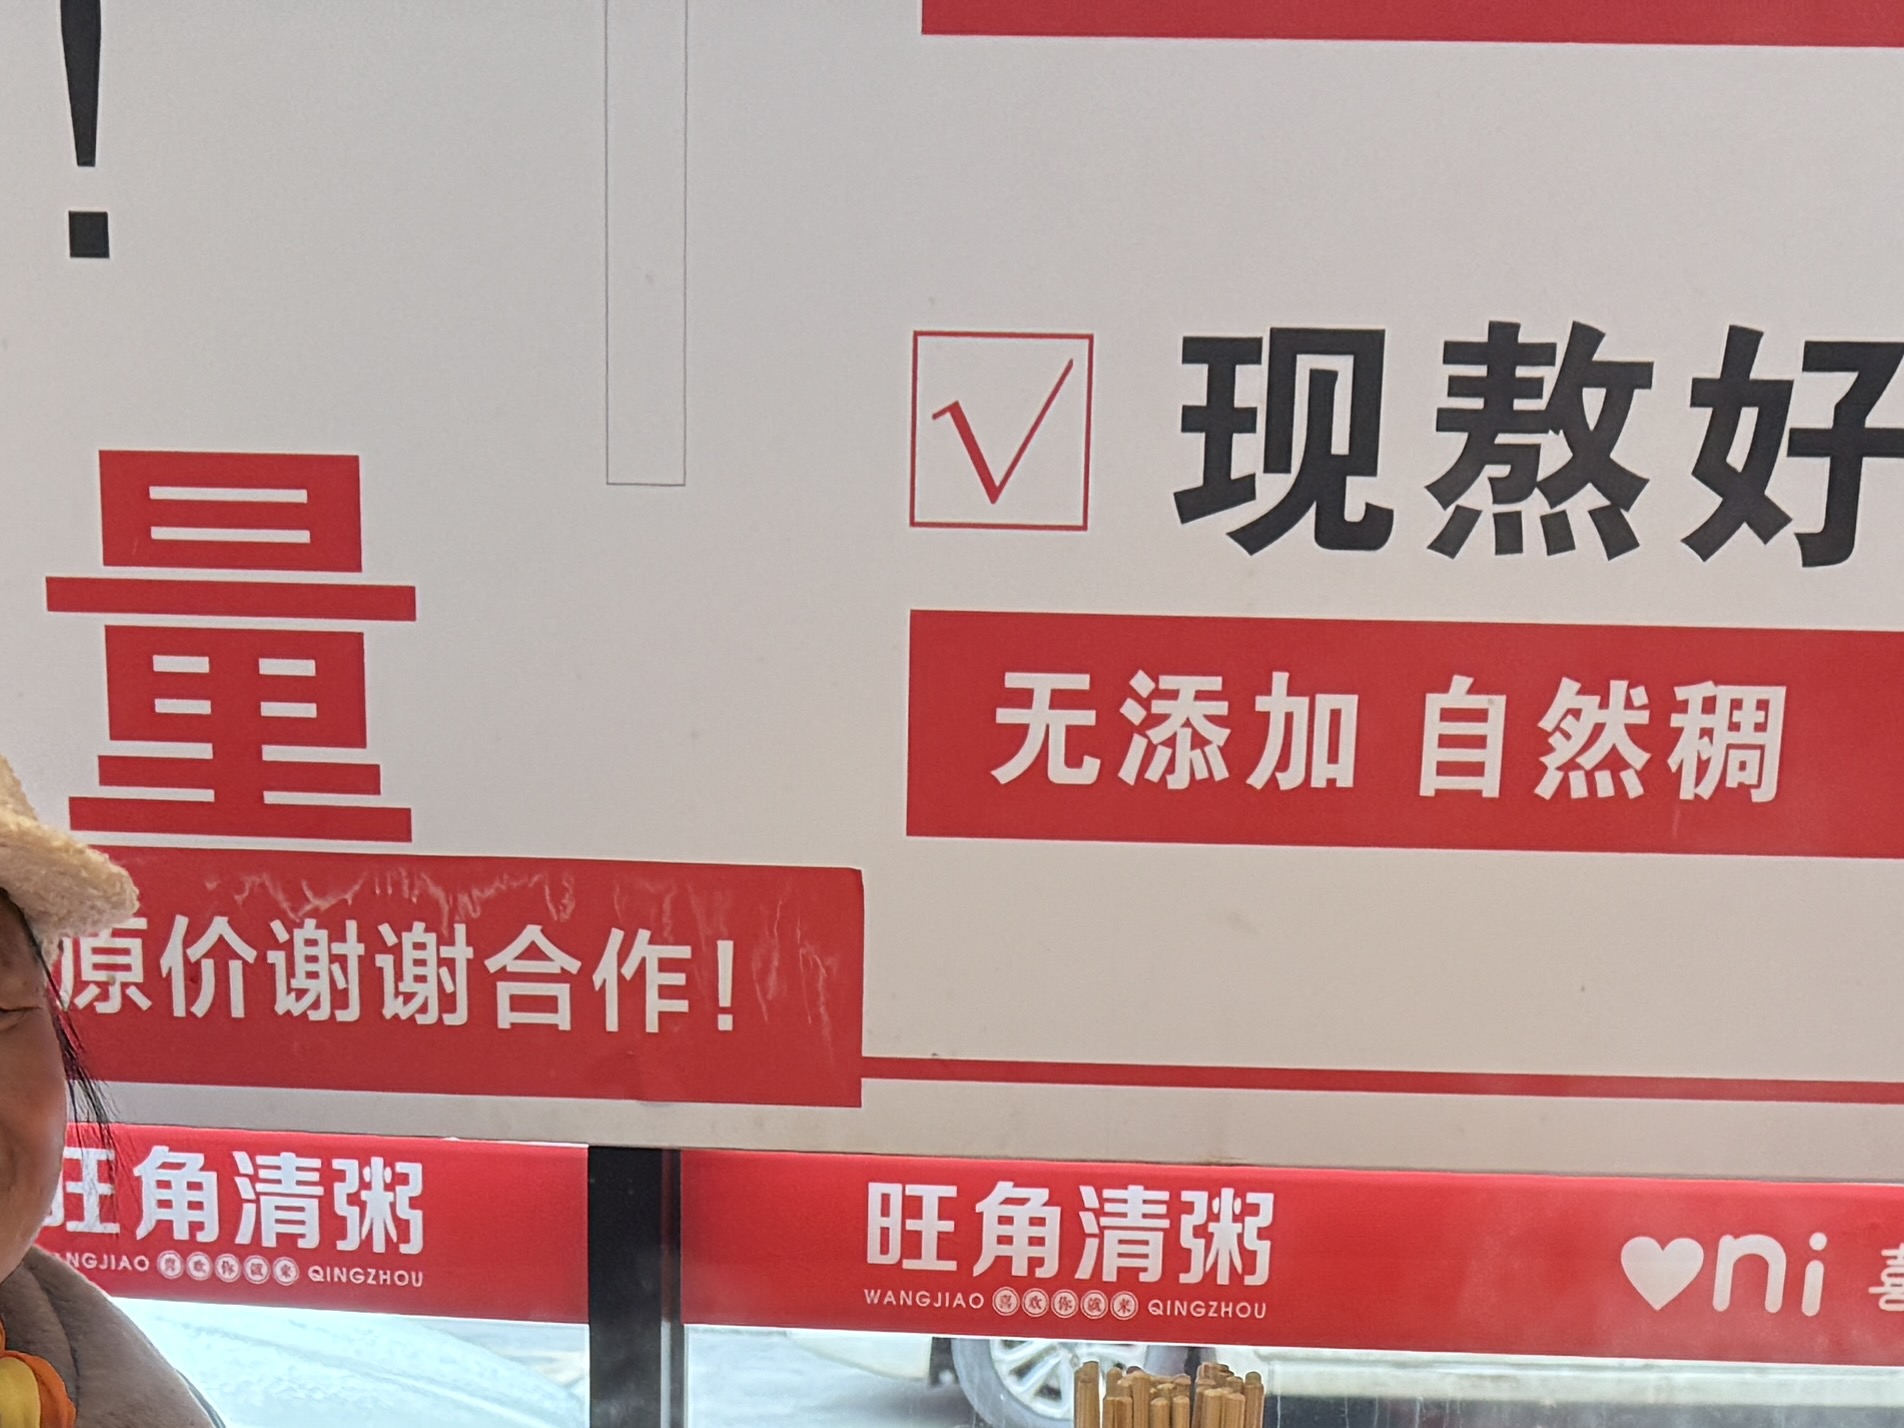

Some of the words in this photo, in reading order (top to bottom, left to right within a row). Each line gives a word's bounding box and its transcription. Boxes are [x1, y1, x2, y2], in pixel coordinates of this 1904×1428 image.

[990, 669, 1361, 792] 无添加
[1418, 673, 1789, 805] 自然稠
[53, 914, 736, 1034] 原价谢谢合作！
[52, 1250, 150, 1273] NGJIAO
[307, 1264, 424, 1289] QINGZHOU
[866, 1180, 1276, 1286] 旺角清粥
[863, 1288, 985, 1310] WANGJIAO
[1147, 1298, 1268, 1320] QINGZHOU
